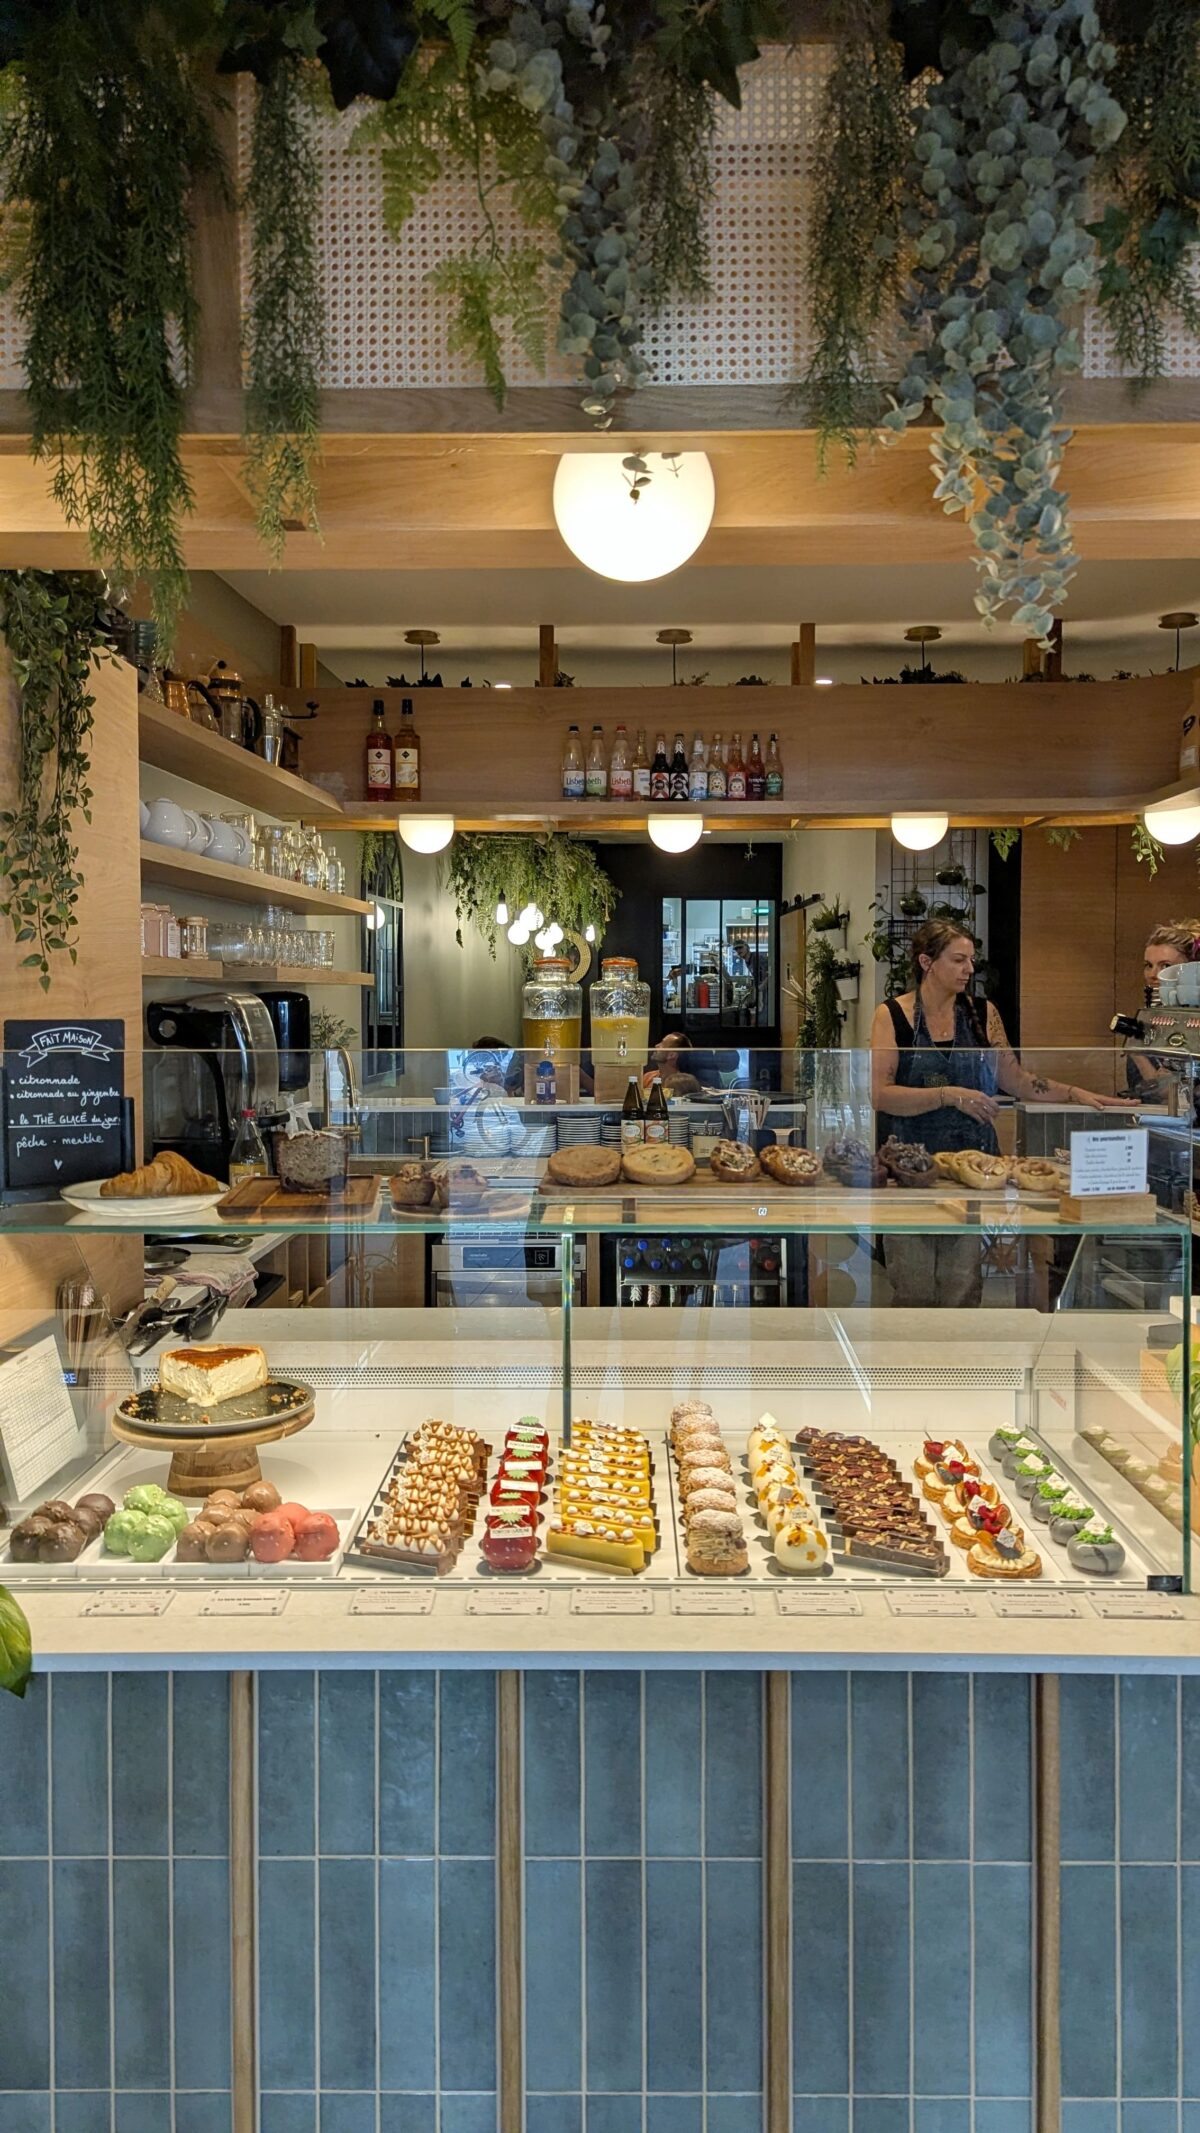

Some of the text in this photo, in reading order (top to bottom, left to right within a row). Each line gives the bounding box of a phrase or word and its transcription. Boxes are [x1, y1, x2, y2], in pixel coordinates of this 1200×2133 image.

[19, 1074, 80, 1085] citronnade
[16, 1090, 64, 1099] citronnade
[80, 1086, 120, 1107] gingembre
[33, 1112, 56, 1125] THÉ
[59, 1111, 88, 1126] GLACÉ
[91, 1114, 102, 1123] du
[16, 1134, 48, 1158] pêche
[62, 1132, 104, 1145] menthe
